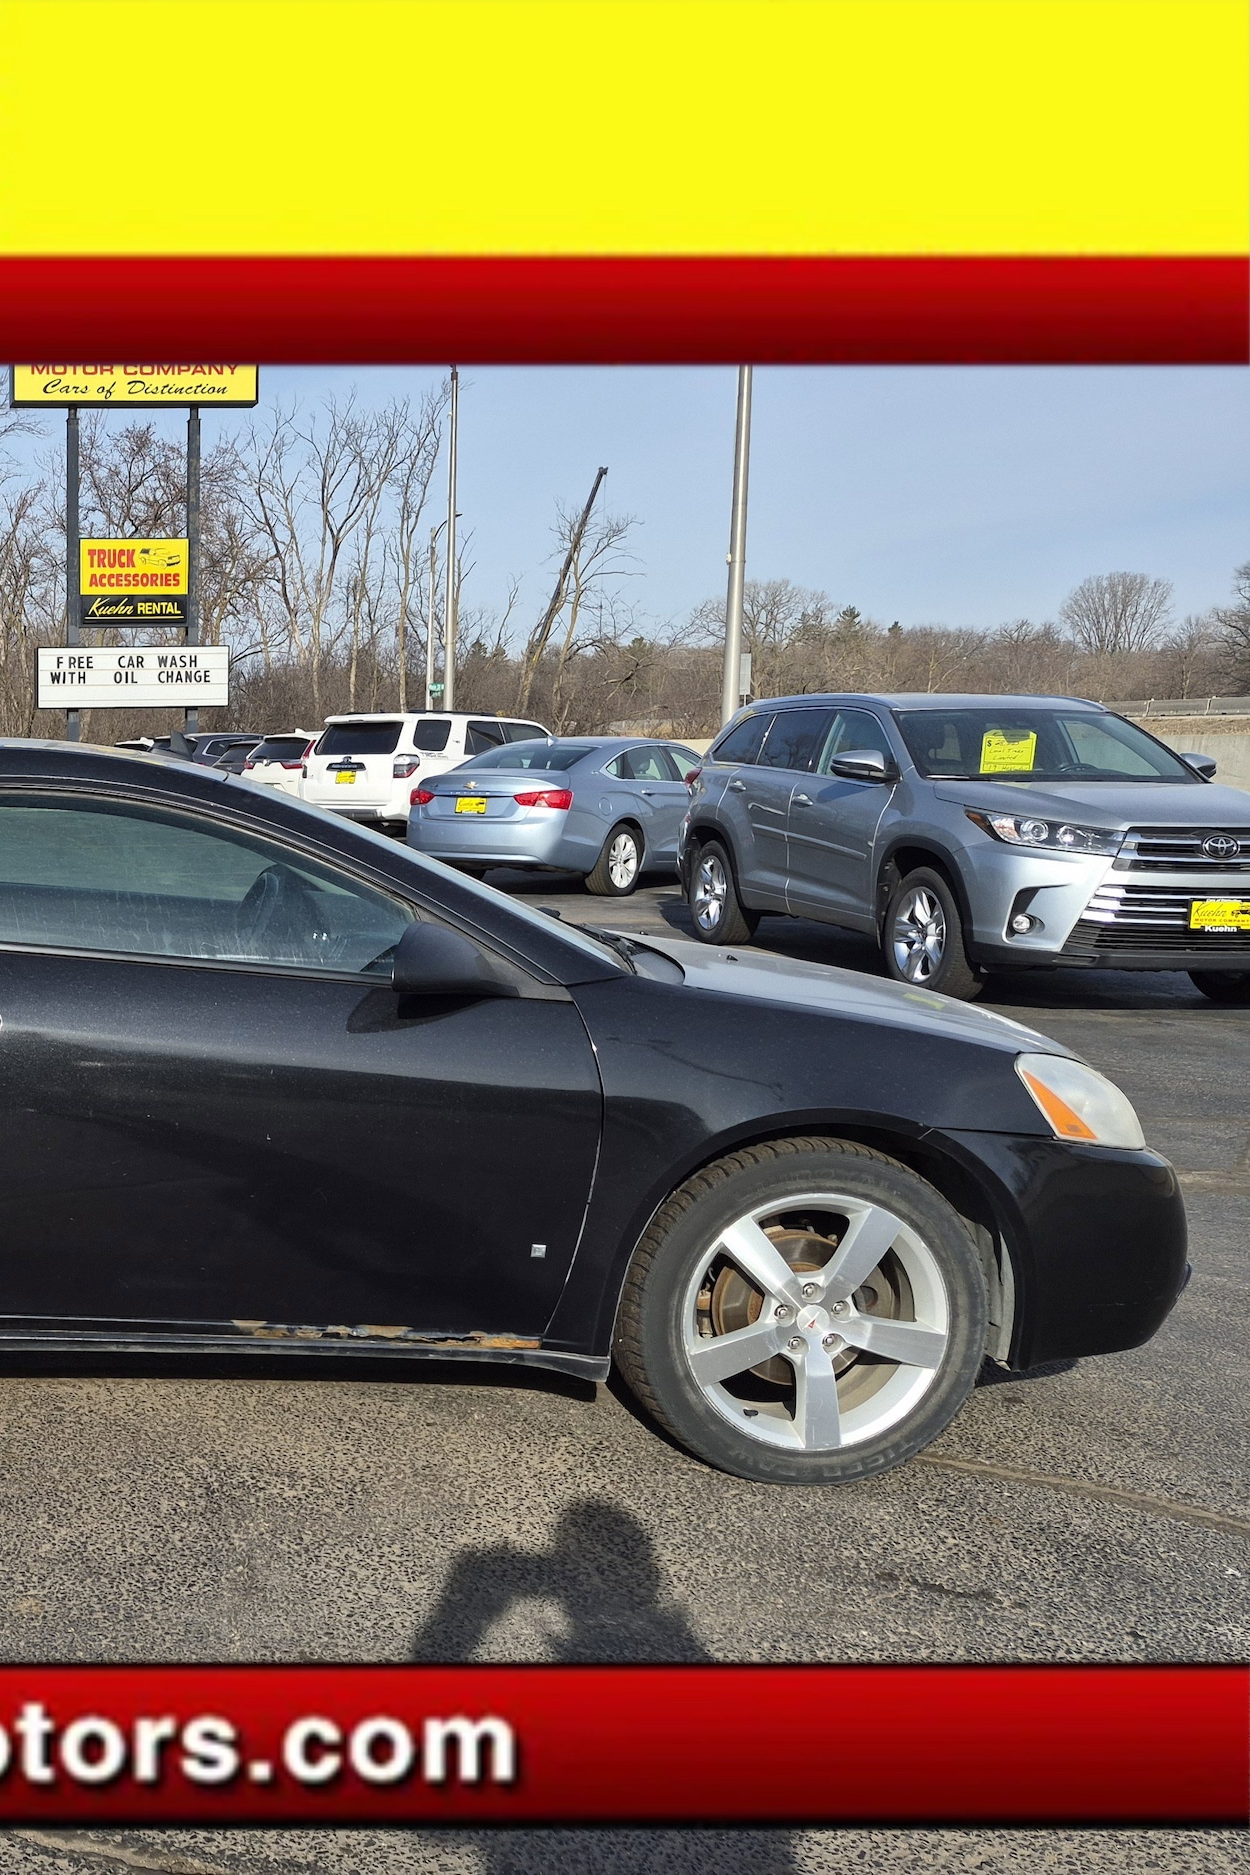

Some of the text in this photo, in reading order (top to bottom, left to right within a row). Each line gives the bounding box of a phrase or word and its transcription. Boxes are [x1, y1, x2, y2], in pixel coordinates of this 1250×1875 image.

[31, 364, 238, 376] MOTOR COMPANY
[42, 378, 228, 399] Cars of Distinction
[87, 549, 136, 568] TRUCK
[89, 573, 181, 587] ACCESSORIES
[88, 598, 181, 617] Kuehn RENTAL
[56, 655, 197, 669] FREE CAR WASH
[50, 670, 211, 684] WITH OIL CHANGE
[1193, 902, 1227, 918] Kuehn
[1204, 924, 1238, 932] Kuehn
